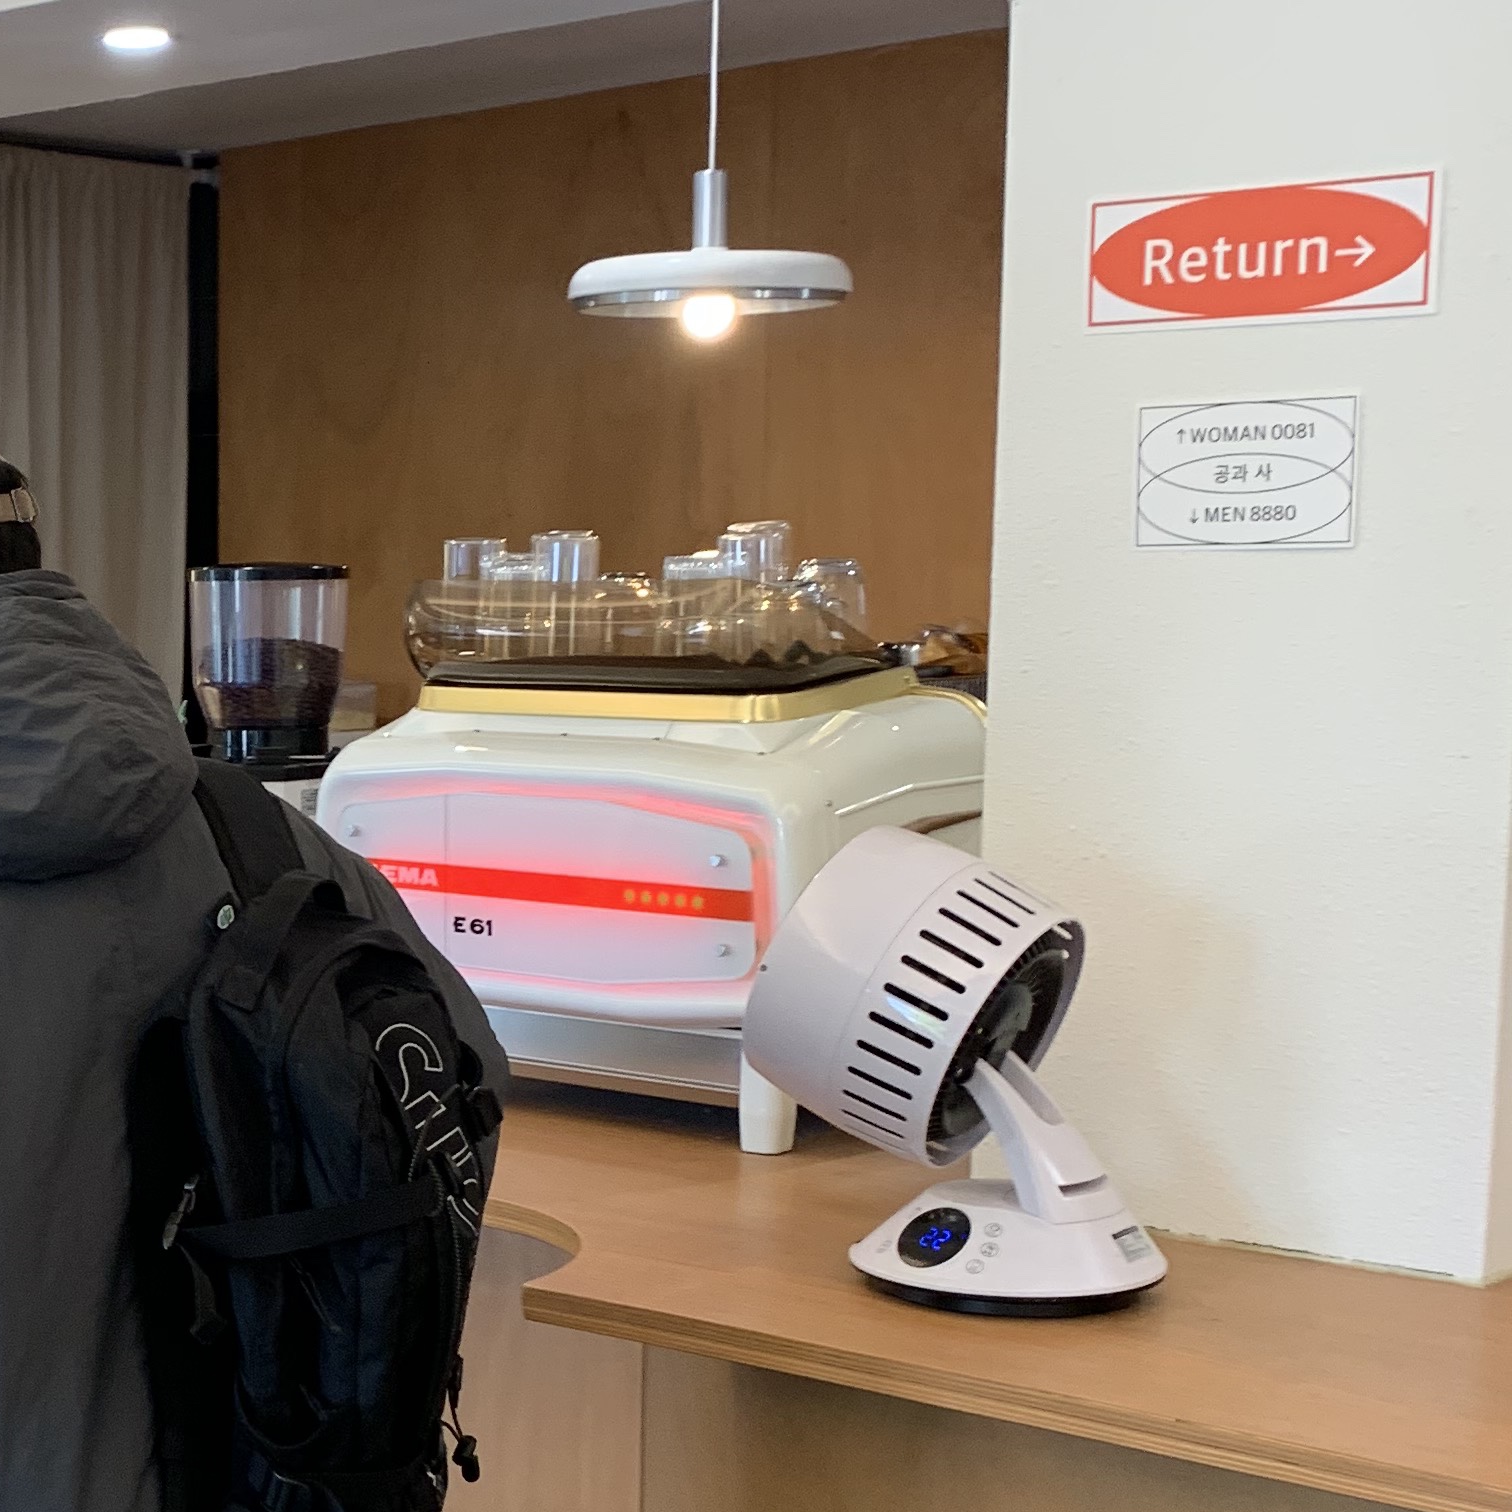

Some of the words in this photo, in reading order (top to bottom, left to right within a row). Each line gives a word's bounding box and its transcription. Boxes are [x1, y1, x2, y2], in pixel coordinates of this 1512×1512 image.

[1143, 236, 1329, 286] Return
[1190, 425, 1266, 443] WOMAN
[1271, 422, 1316, 440] 0081
[1214, 464, 1248, 484] 공과
[1254, 463, 1273, 482] 사
[1204, 507, 1245, 523] MEN
[1249, 504, 1297, 522] 8880
[373, 863, 439, 886] EMA
